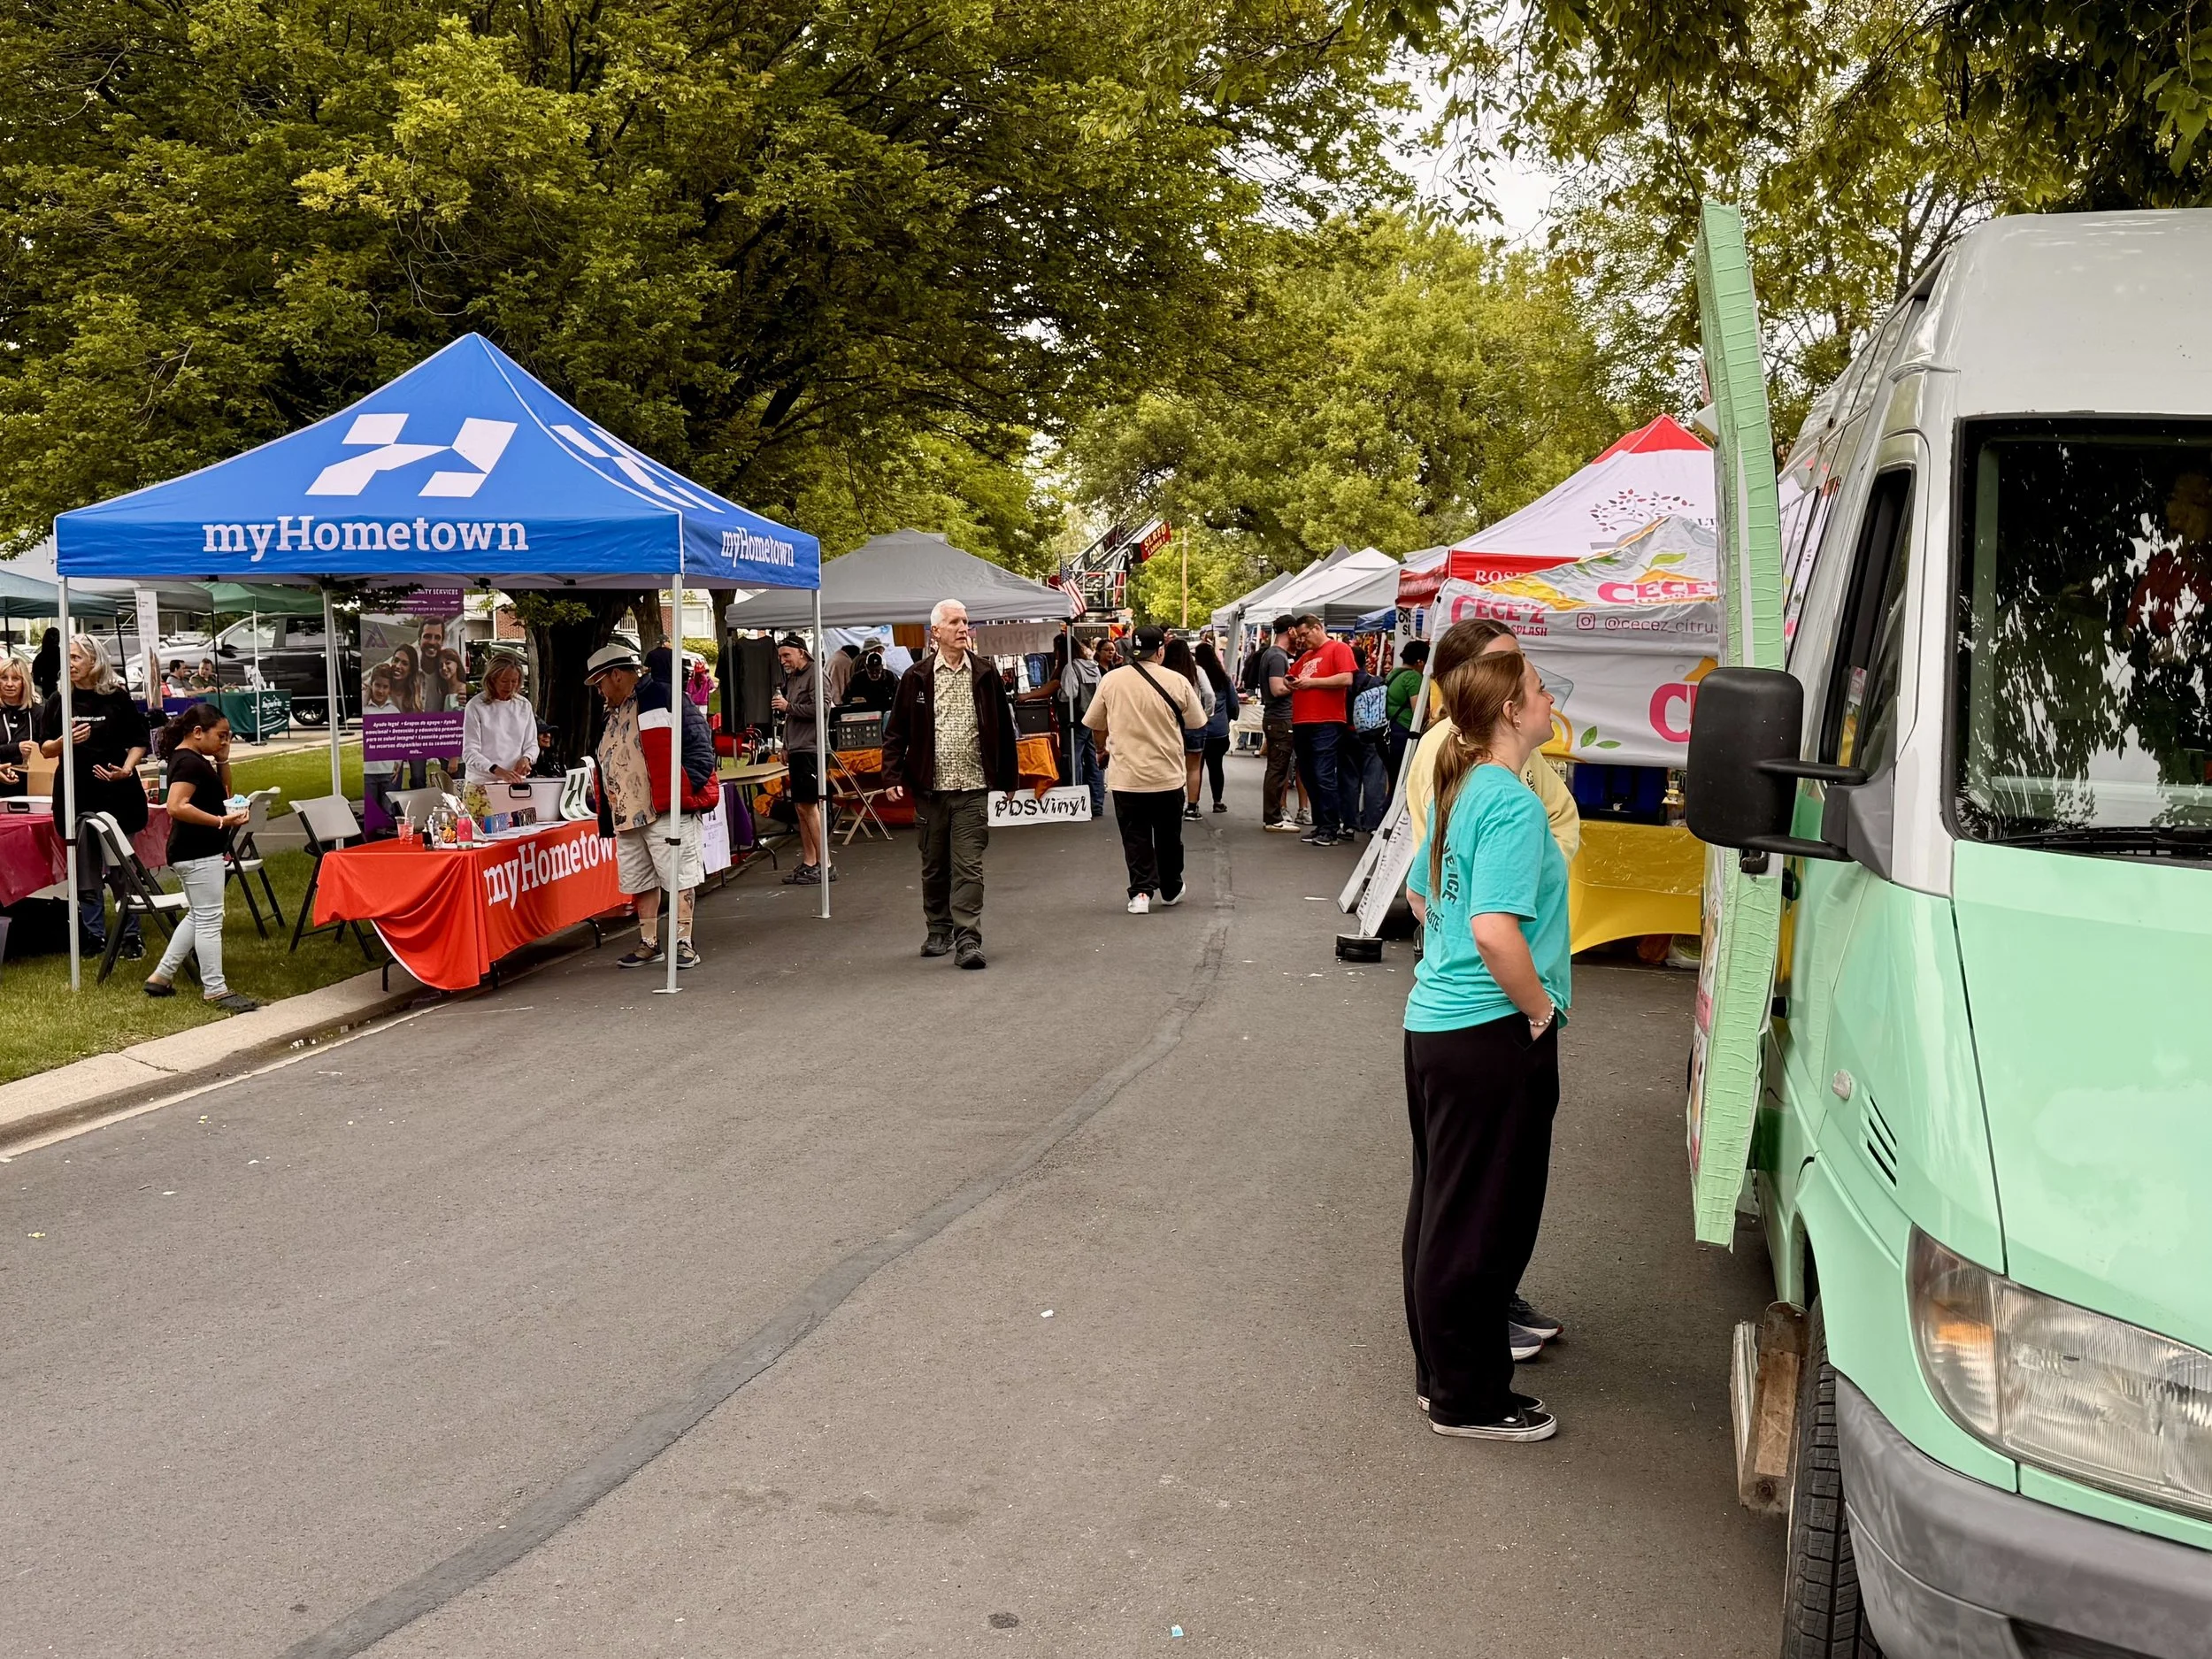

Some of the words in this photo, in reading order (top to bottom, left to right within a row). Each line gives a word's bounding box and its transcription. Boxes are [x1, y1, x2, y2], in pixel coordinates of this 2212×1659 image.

[202, 515, 530, 563] myHometown
[720, 526, 795, 568] myHometown
[1474, 570, 1525, 583] ROS
[1511, 624, 1548, 637] SPLASH
[482, 829, 619, 911] myHometow
[1441, 873, 1460, 906] ICE
